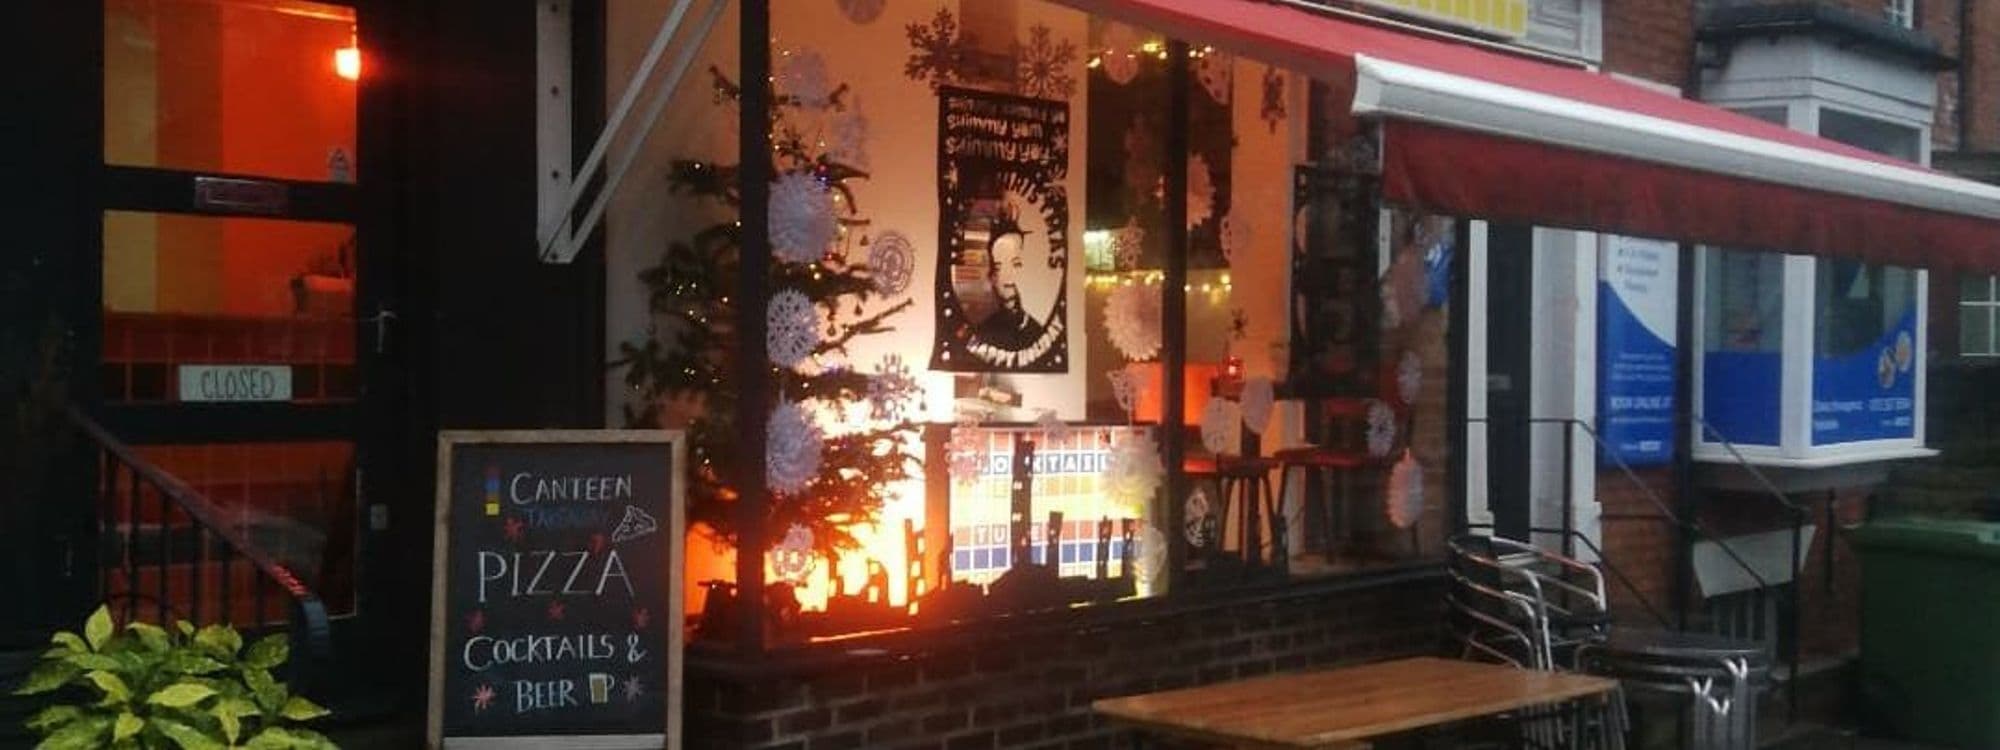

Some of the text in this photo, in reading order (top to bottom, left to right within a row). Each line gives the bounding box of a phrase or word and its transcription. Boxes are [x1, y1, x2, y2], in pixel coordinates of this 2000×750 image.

[201, 367, 276, 401] CLOSED
[510, 472, 632, 505] CANTEEN
[478, 550, 634, 602] PIZZA
[464, 633, 647, 672] COCKTAILS &
[515, 678, 578, 712] BEER
